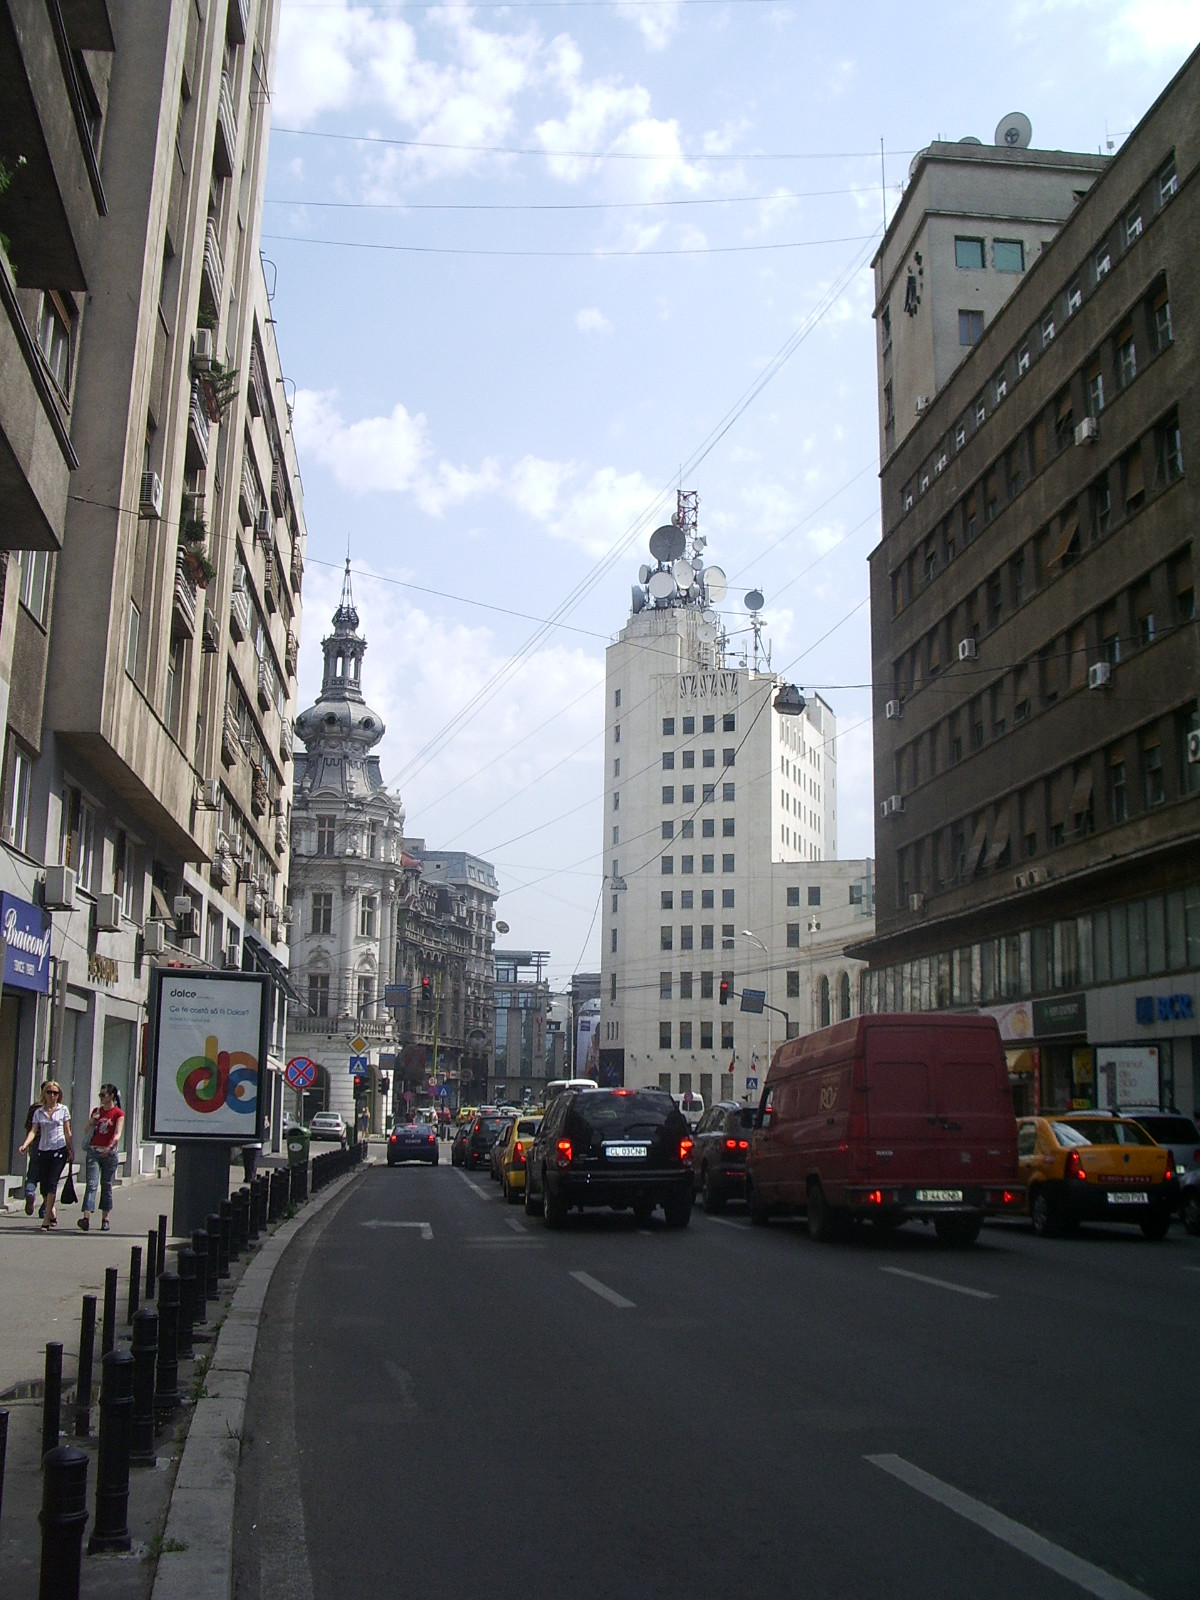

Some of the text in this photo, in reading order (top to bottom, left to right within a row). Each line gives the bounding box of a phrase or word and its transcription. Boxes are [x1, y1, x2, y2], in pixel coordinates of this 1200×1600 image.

[3, 908, 51, 972] Braiconf
[170, 988, 197, 999] dolce
[169, 1005, 180, 1013] Ce
[1157, 994, 1194, 1021] BCR
[610, 1147, 619, 1156] CL
